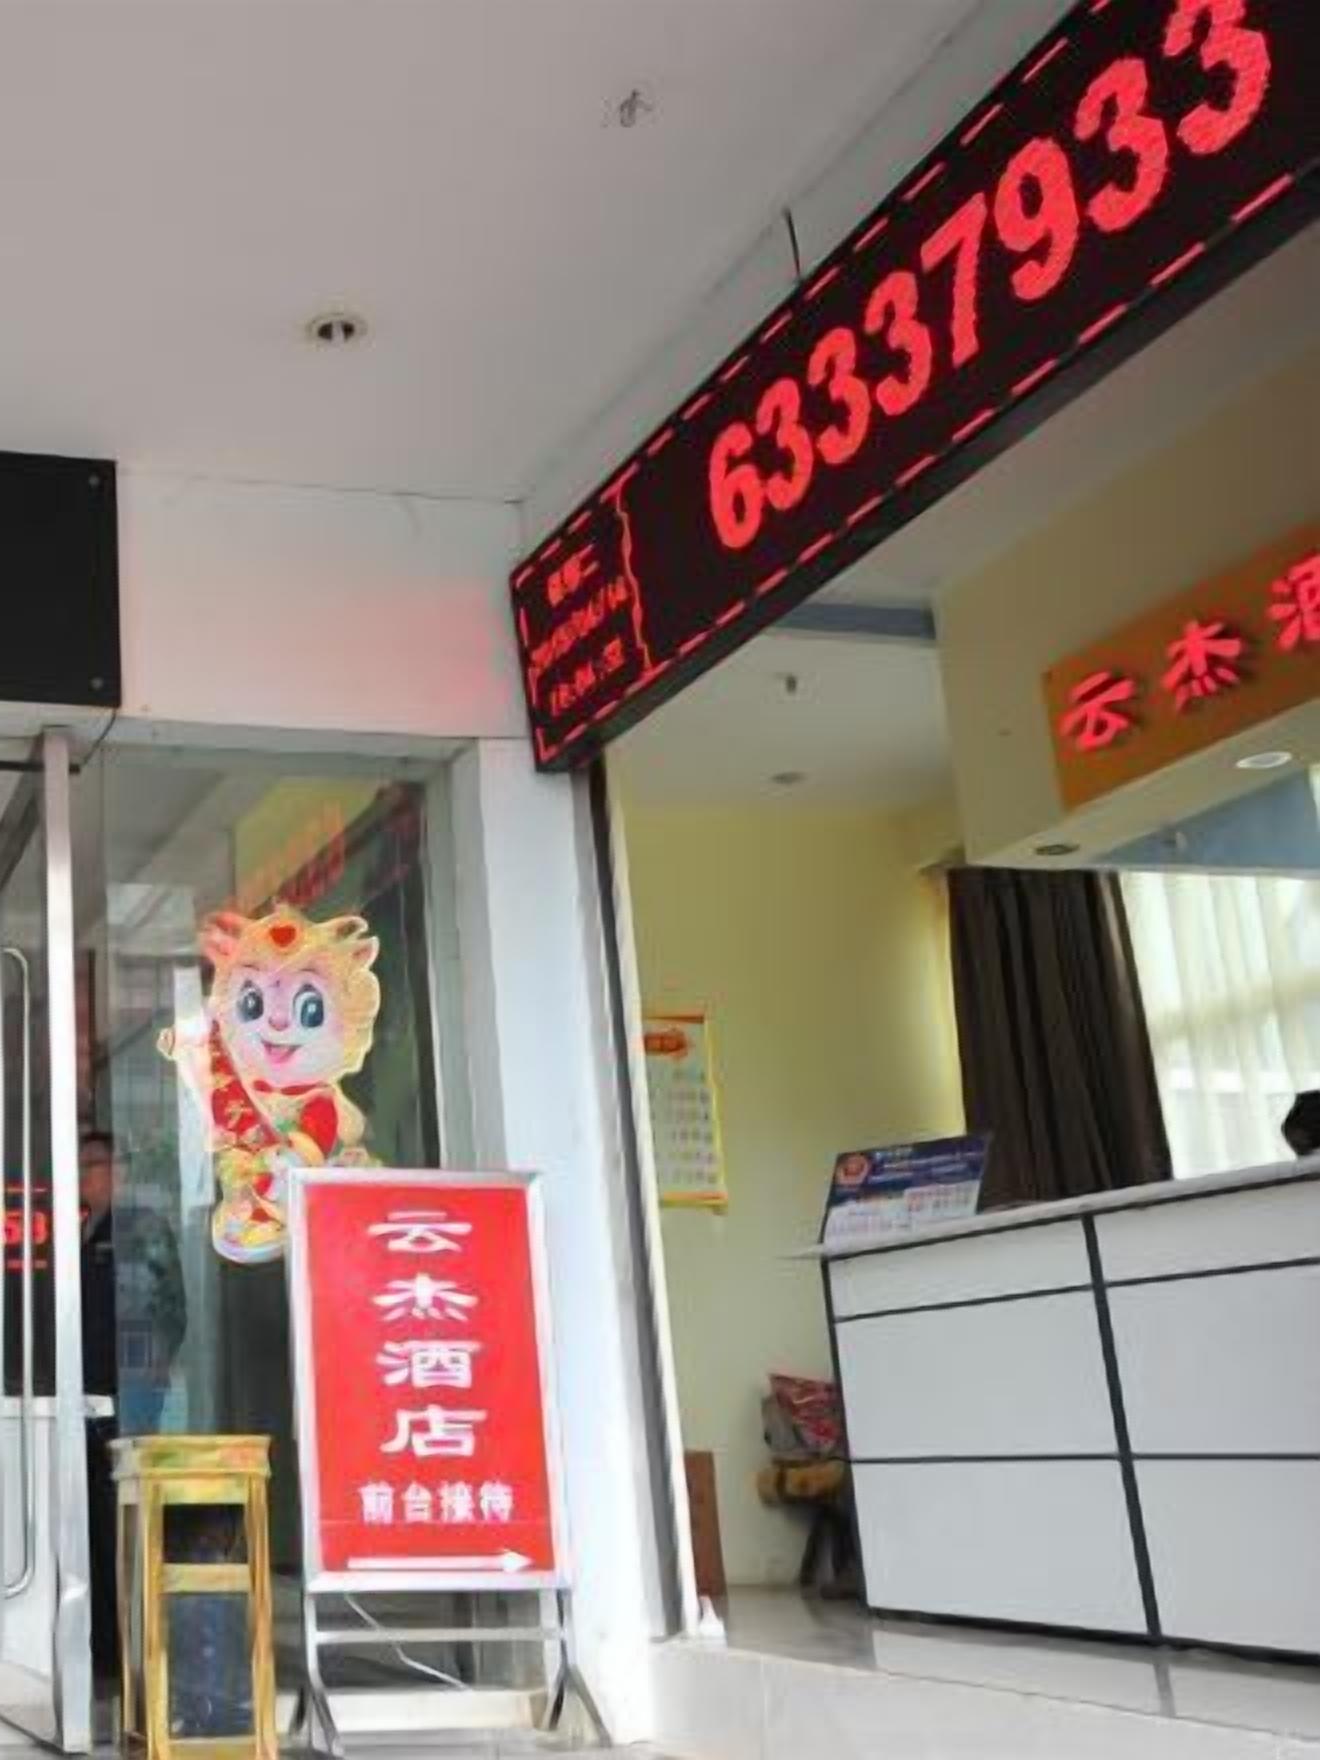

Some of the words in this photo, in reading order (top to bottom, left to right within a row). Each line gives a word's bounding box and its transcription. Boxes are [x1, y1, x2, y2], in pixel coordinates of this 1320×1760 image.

[709, 0, 1272, 550] 63337933
[366, 1210, 488, 1458] 云杰酒店
[359, 1480, 514, 1525] 前台接待
